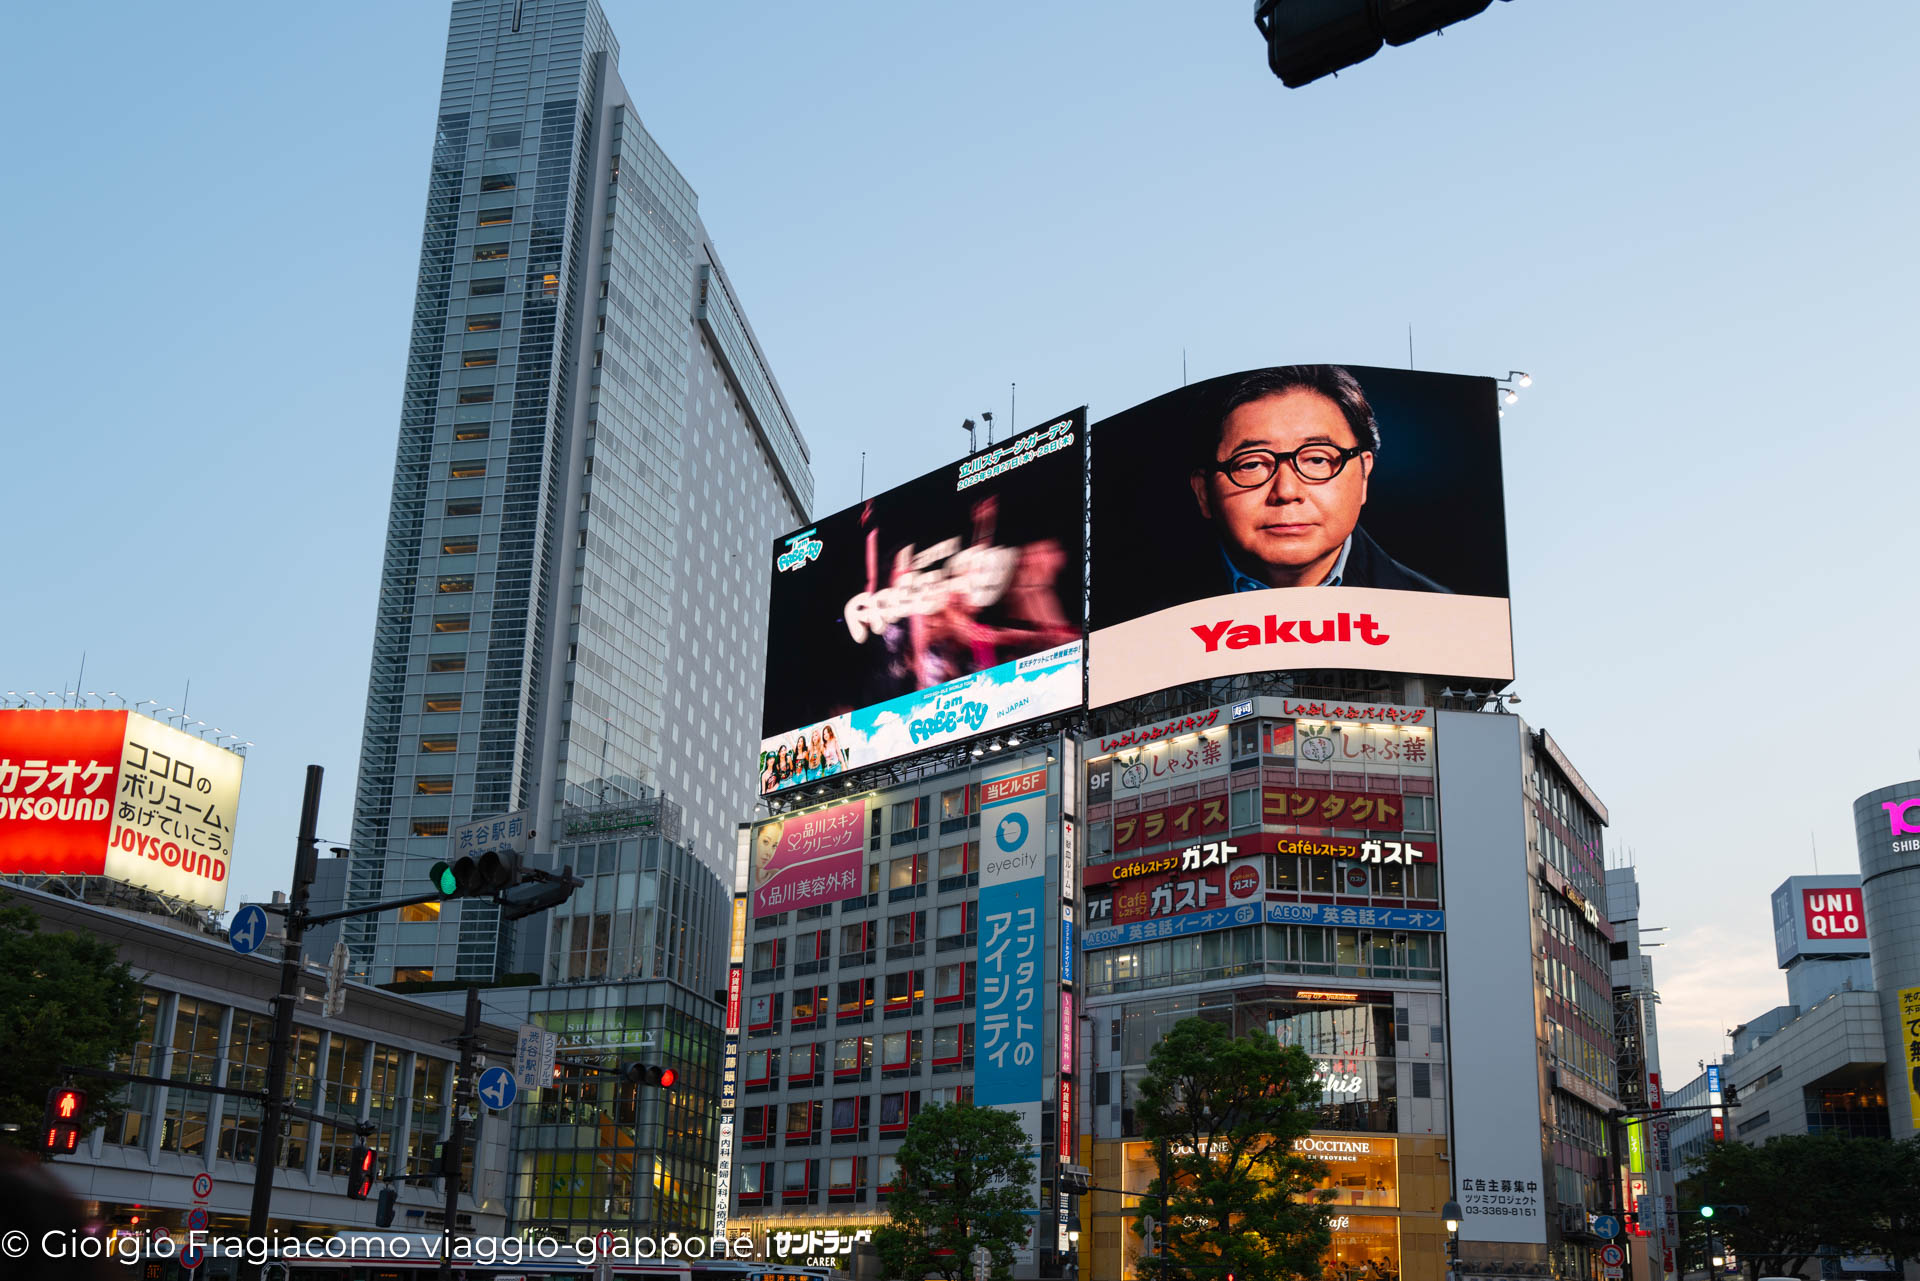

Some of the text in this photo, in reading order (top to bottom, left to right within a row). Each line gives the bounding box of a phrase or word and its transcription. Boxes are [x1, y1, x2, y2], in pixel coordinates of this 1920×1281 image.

[959, 420, 1073, 480] 立川ステージガーデン
[1190, 612, 1390, 653] Yakult
[944, 696, 963, 709] am
[996, 697, 1030, 718] IN JAPAN
[1284, 700, 1427, 723] しゃぶしゃぶバイキング
[909, 701, 989, 744] FREE-TY
[1100, 709, 1220, 752] しゃぶしゃぶバイキング
[1153, 739, 1222, 776] しゃぶ葉
[1343, 734, 1427, 762] しゃぶ葉
[0, 759, 114, 795] カラオケ
[127, 741, 212, 794] ココロの
[988, 774, 1040, 800] 当ビル5F
[1090, 772, 1111, 790] 9F
[122, 774, 230, 833] ボリューム、
[1264, 793, 1397, 822] コンタクト
[119, 801, 229, 856] あげていこう。
[459, 817, 523, 849] 渋谷駅前
[803, 812, 860, 838] 品川スキン
[1116, 800, 1225, 844] プライス
[111, 825, 226, 882] JOYSOUND
[803, 830, 853, 855] クリニック
[1360, 840, 1423, 865] ガスト
[986, 853, 1037, 876] eyecity
[1182, 841, 1238, 871] ガスト
[768, 868, 856, 906] 品川美容外科
[1150, 879, 1220, 917] ガスト
[1233, 879, 1257, 891] ガスト
[1088, 899, 1112, 919] 7F
[1118, 892, 1147, 909] Café
[1272, 906, 1313, 919] AEON
[1809, 894, 1853, 912] UNI
[1129, 912, 1230, 941] 英会話イーオン
[1323, 907, 1441, 928] 英会話イーオン
[1811, 915, 1859, 937] QLO
[1087, 930, 1119, 946] AEON
[984, 911, 1012, 1068] アイシティ
[1014, 907, 1035, 1066] コンタクトの
[557, 1030, 657, 1046] ARK CITY
[524, 1032, 539, 1085] 渋谷駅前
[723, 1043, 737, 1097] 加藤眼科
[721, 1116, 733, 1124] 3F
[1462, 1178, 1537, 1193] 広告主募集中
[1465, 1195, 1536, 1205] ツツミプロジェクト
[1466, 1206, 1536, 1216] 03-3369-8151
[776, 1229, 873, 1255] サンドラッグ
[806, 1257, 836, 1266] CARER
